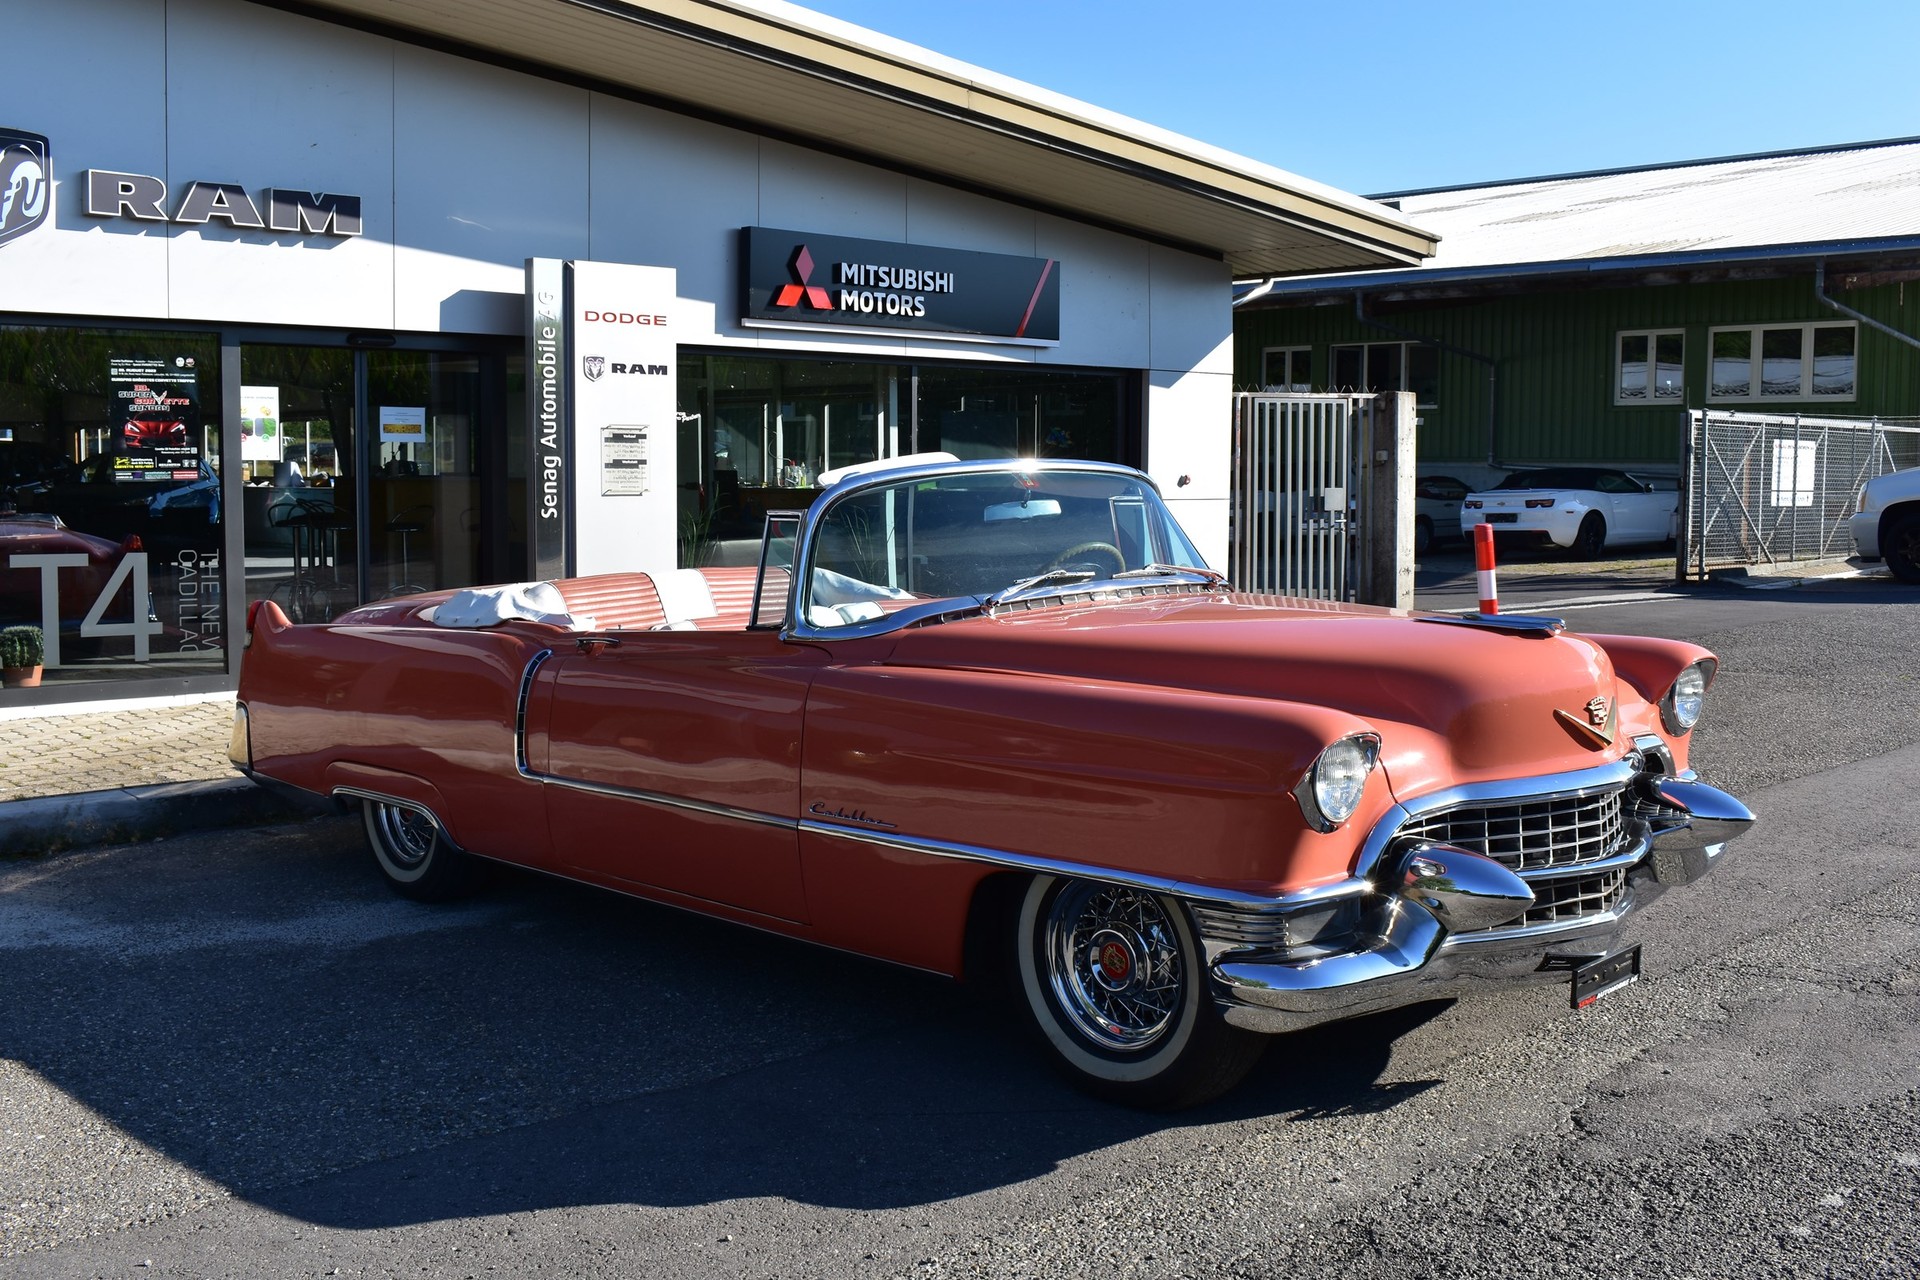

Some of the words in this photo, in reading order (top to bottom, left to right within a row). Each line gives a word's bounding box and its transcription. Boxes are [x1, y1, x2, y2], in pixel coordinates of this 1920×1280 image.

[84, 168, 362, 236] RAM
[841, 262, 954, 293] MITSUBISHI
[584, 310, 667, 327] DODGE
[841, 289, 925, 317] MOTORS
[611, 362, 668, 376] RAM
[538, 326, 557, 449] Automobile
[541, 455, 562, 519] Senag
[200, 548, 220, 594] THE
[809, 801, 898, 828] Cadillac
